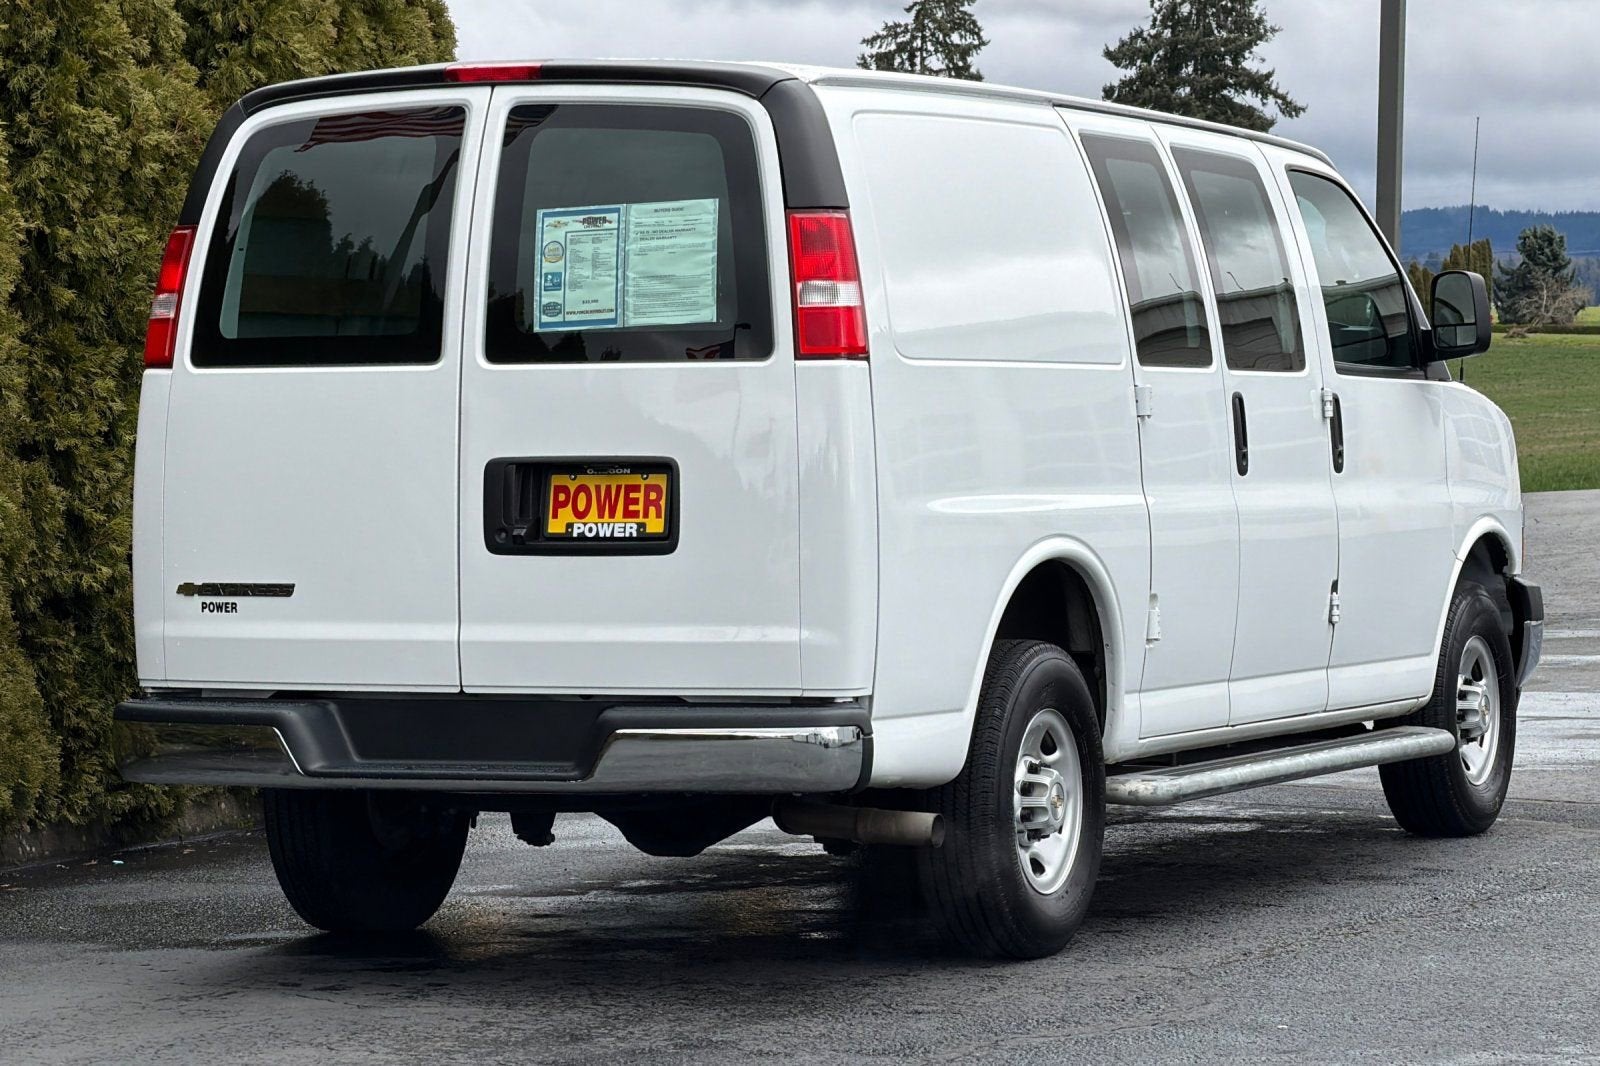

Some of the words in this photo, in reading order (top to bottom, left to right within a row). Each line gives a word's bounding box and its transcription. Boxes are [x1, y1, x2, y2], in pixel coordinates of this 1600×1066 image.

[582, 216, 607, 225] POWER
[551, 484, 663, 520] POWER
[572, 522, 638, 538] POWER
[201, 601, 238, 614] POWER
